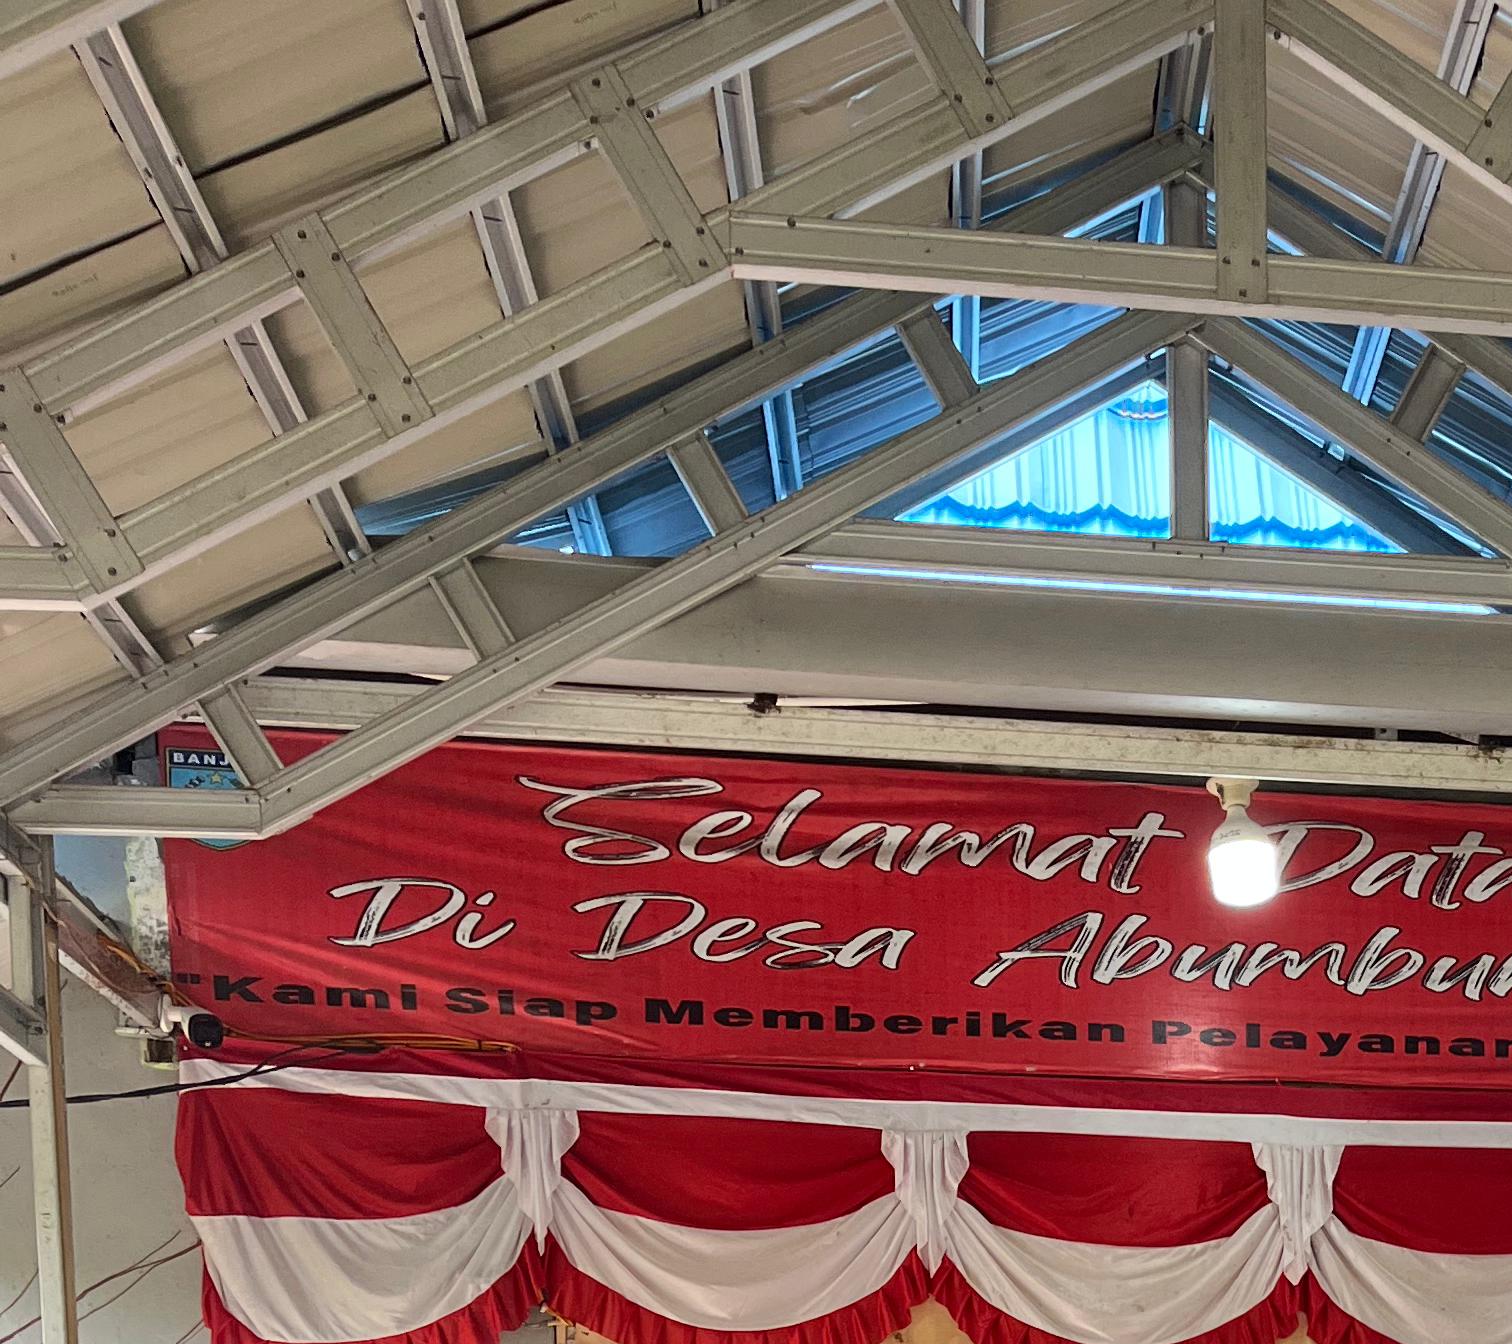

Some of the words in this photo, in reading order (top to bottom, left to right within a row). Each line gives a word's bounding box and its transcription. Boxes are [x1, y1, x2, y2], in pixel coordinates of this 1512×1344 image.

[173, 752, 230, 765] BANJ
[515, 775, 1186, 895] Selamat
[326, 877, 516, 950] Di
[572, 890, 918, 971] Desa
[444, 987, 620, 1026] Siap
[643, 997, 1126, 1043] Memberikan
